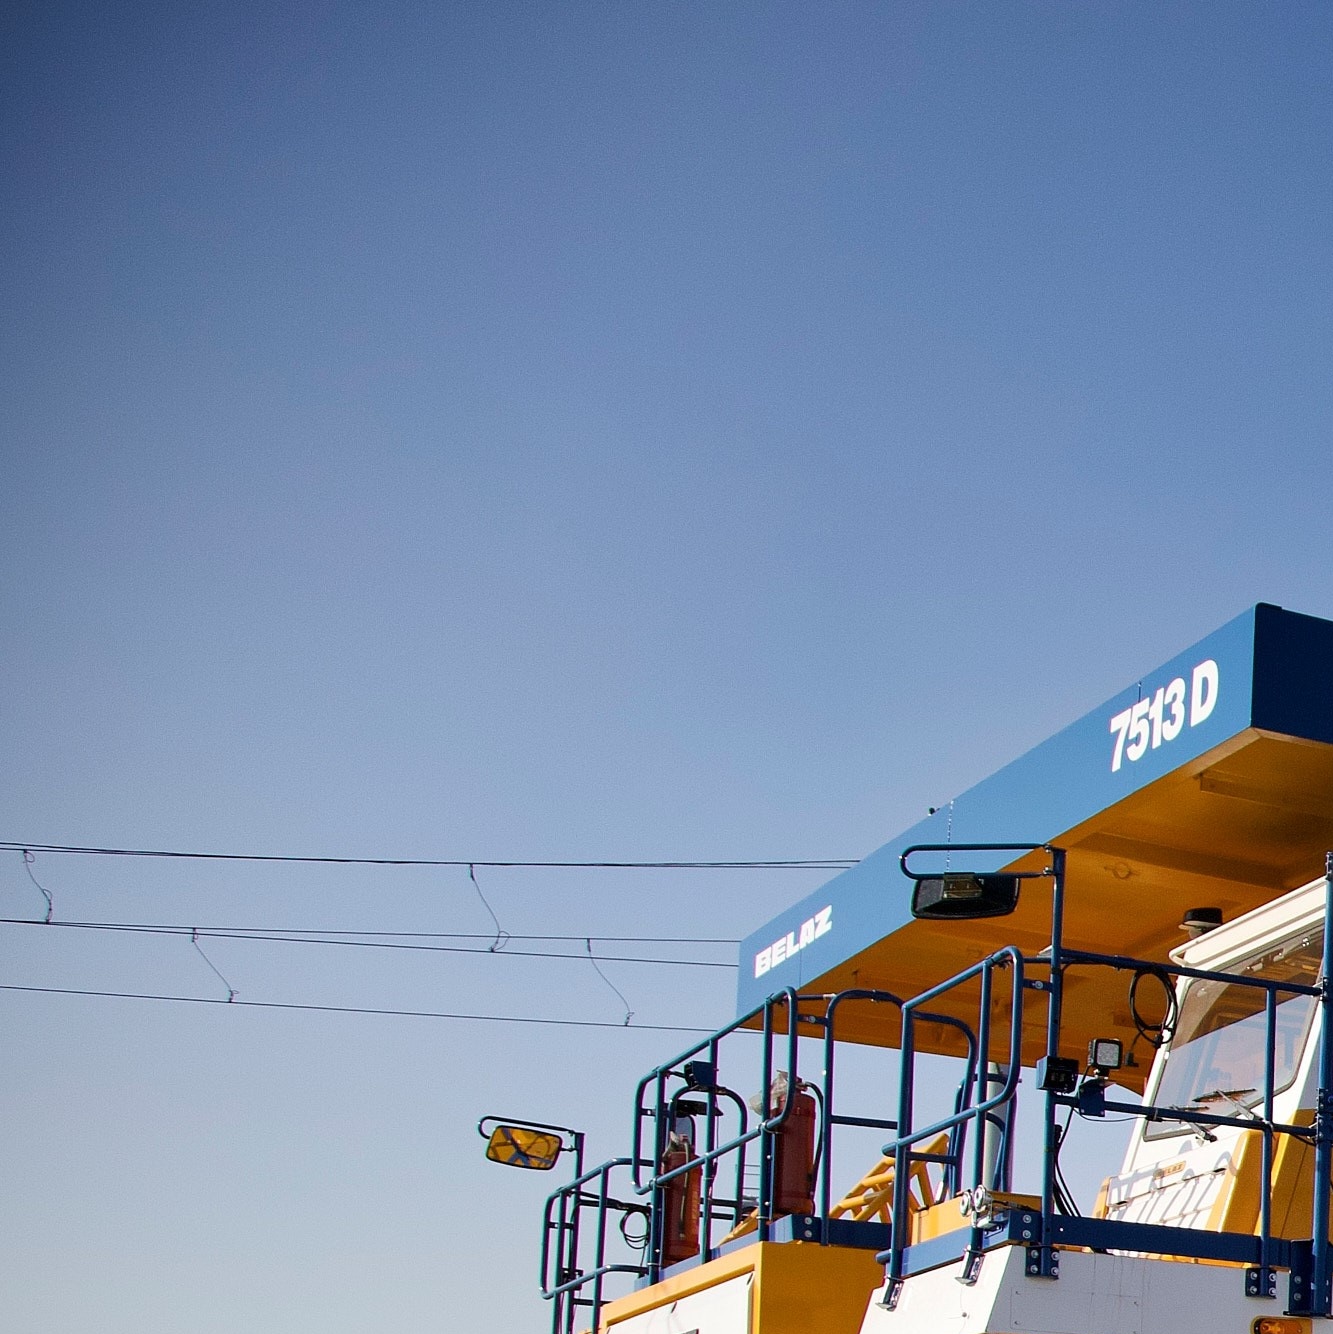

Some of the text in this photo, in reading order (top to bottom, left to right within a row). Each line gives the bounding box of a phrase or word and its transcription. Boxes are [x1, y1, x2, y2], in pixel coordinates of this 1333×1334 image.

[1110, 659, 1219, 773] 7513 D
[754, 904, 833, 979] BELAZ
